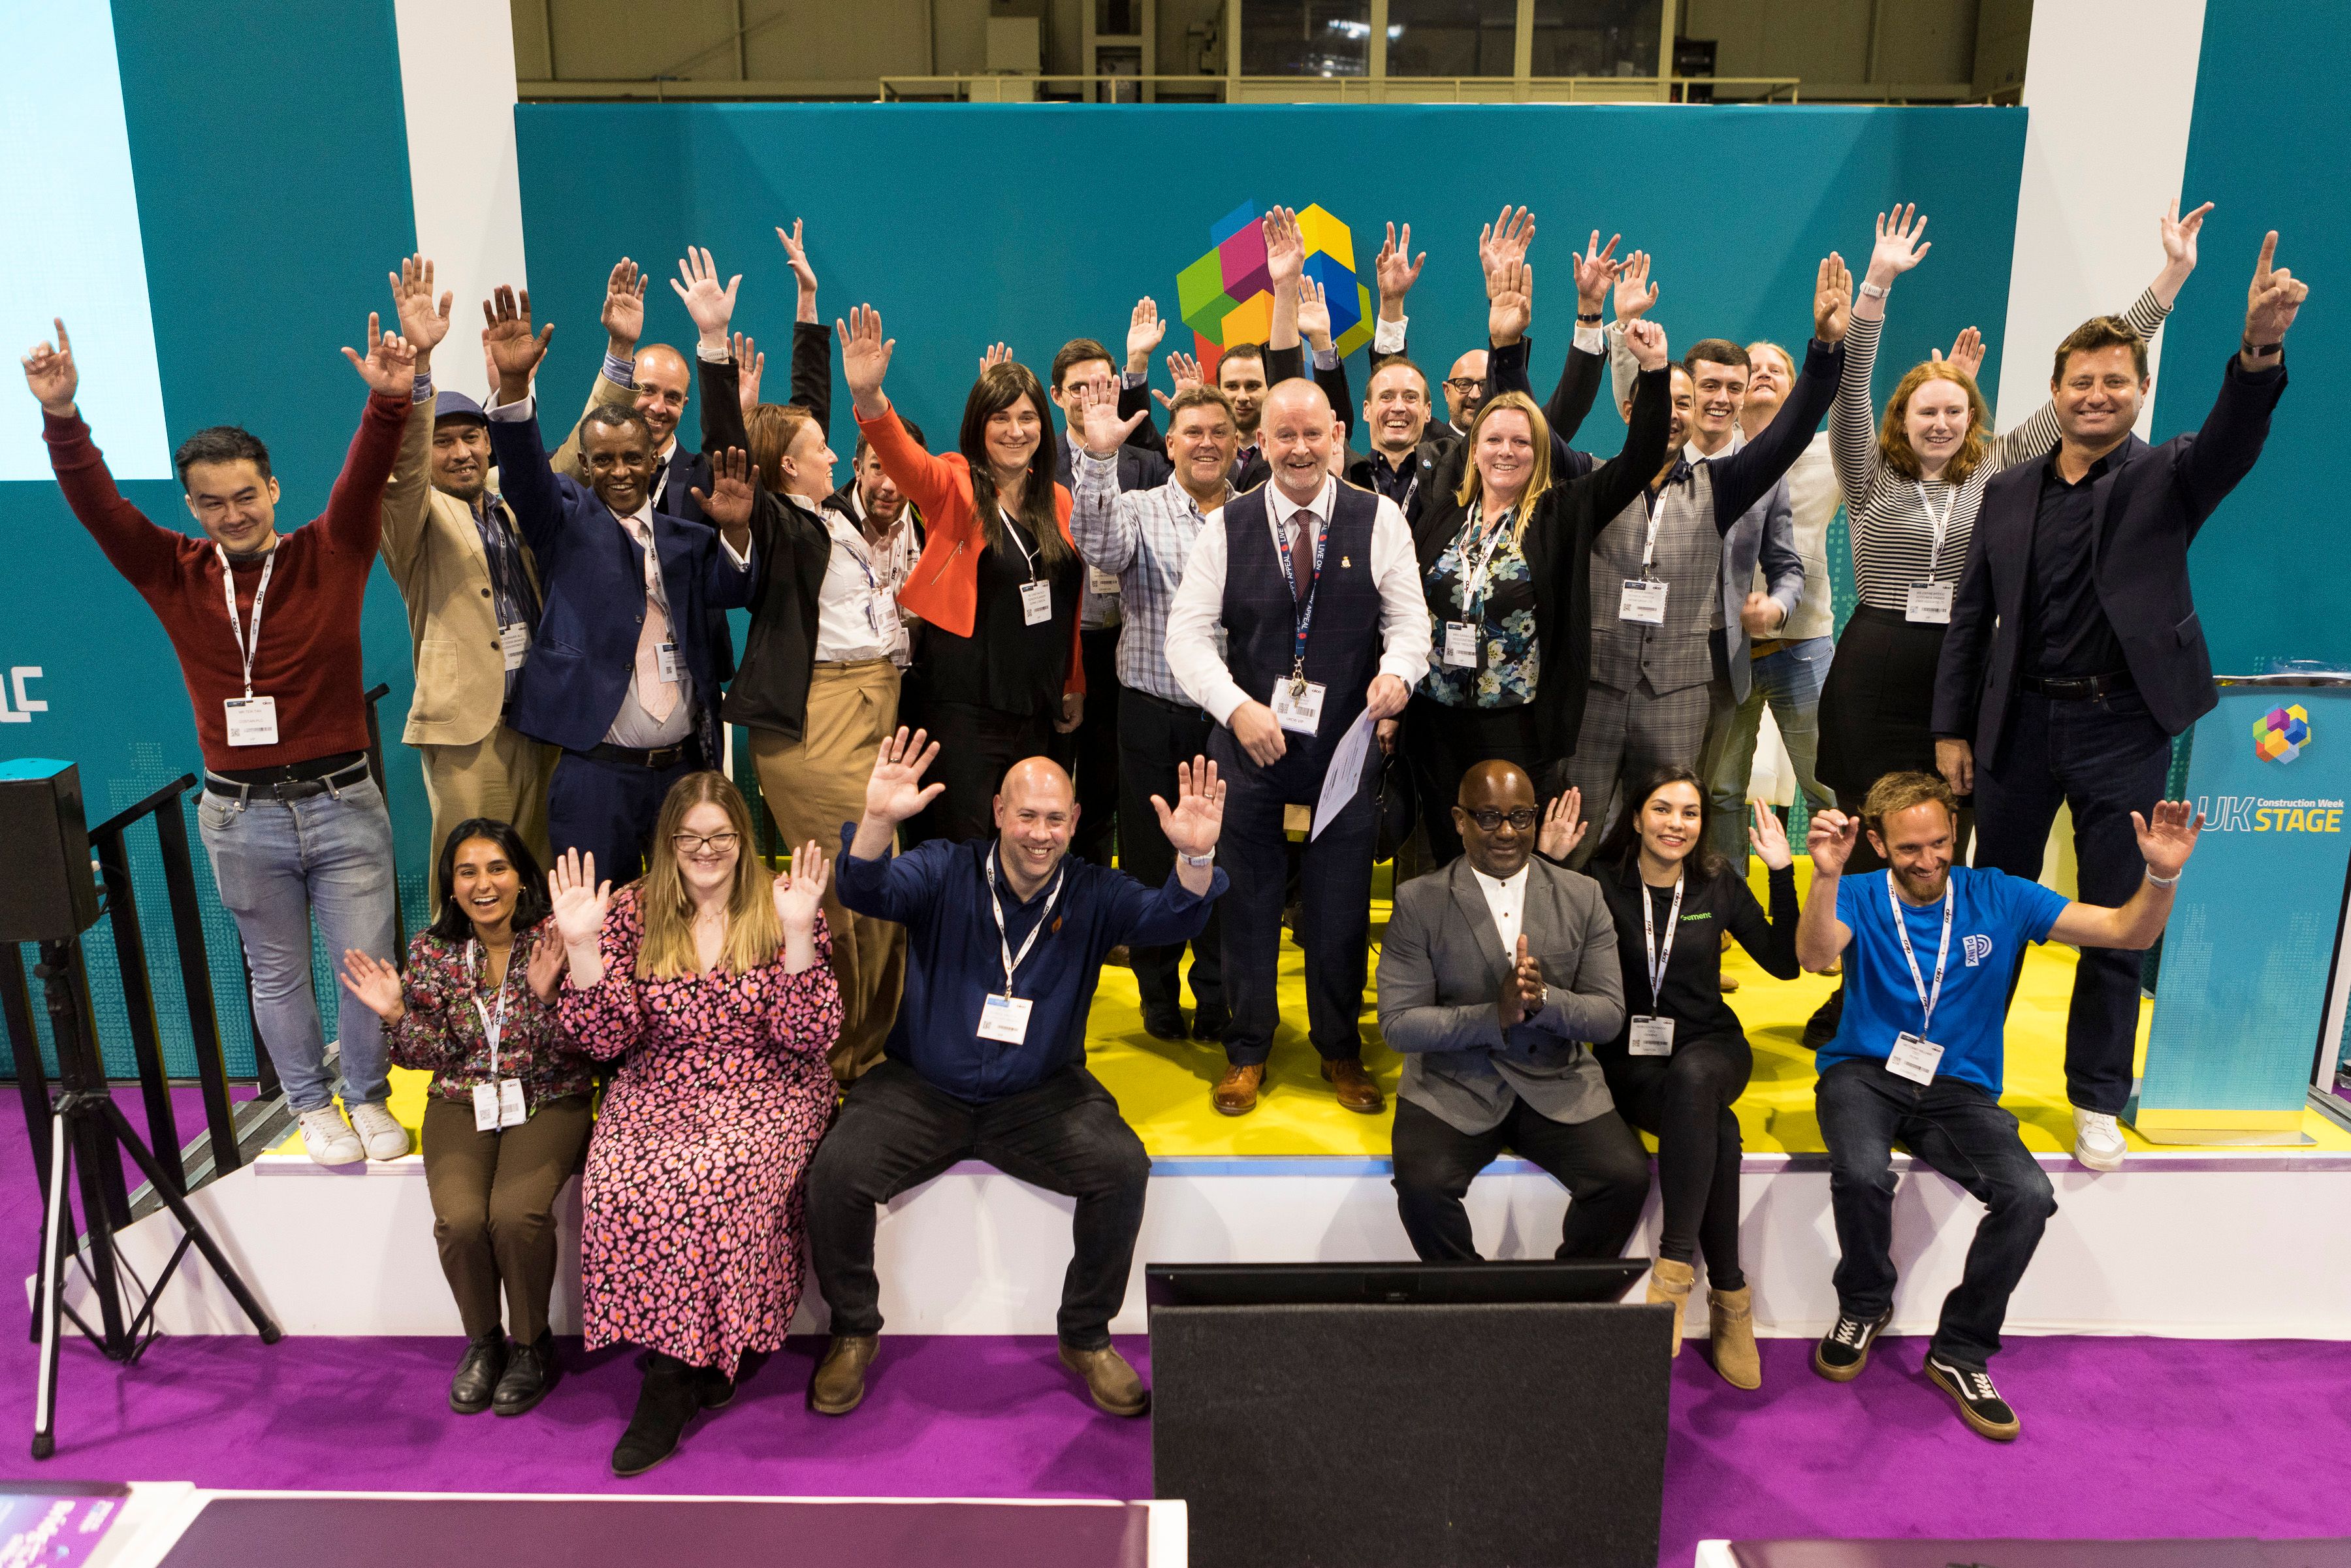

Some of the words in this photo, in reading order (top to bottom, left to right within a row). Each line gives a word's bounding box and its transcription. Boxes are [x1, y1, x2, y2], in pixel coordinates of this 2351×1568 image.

[1278, 527, 1287, 542] LIVE
[1317, 544, 1326, 560] LIVE
[1284, 554, 1294, 580] APPEAL
[1316, 560, 1323, 570] ON
[1302, 605, 1312, 630] APPEAL
[2198, 796, 2255, 832] UK
[2257, 798, 2316, 807] Construction
[2318, 799, 2344, 808] Week
[2254, 808, 2344, 833] STAGE
[1966, 938, 1976, 965] PLINX
